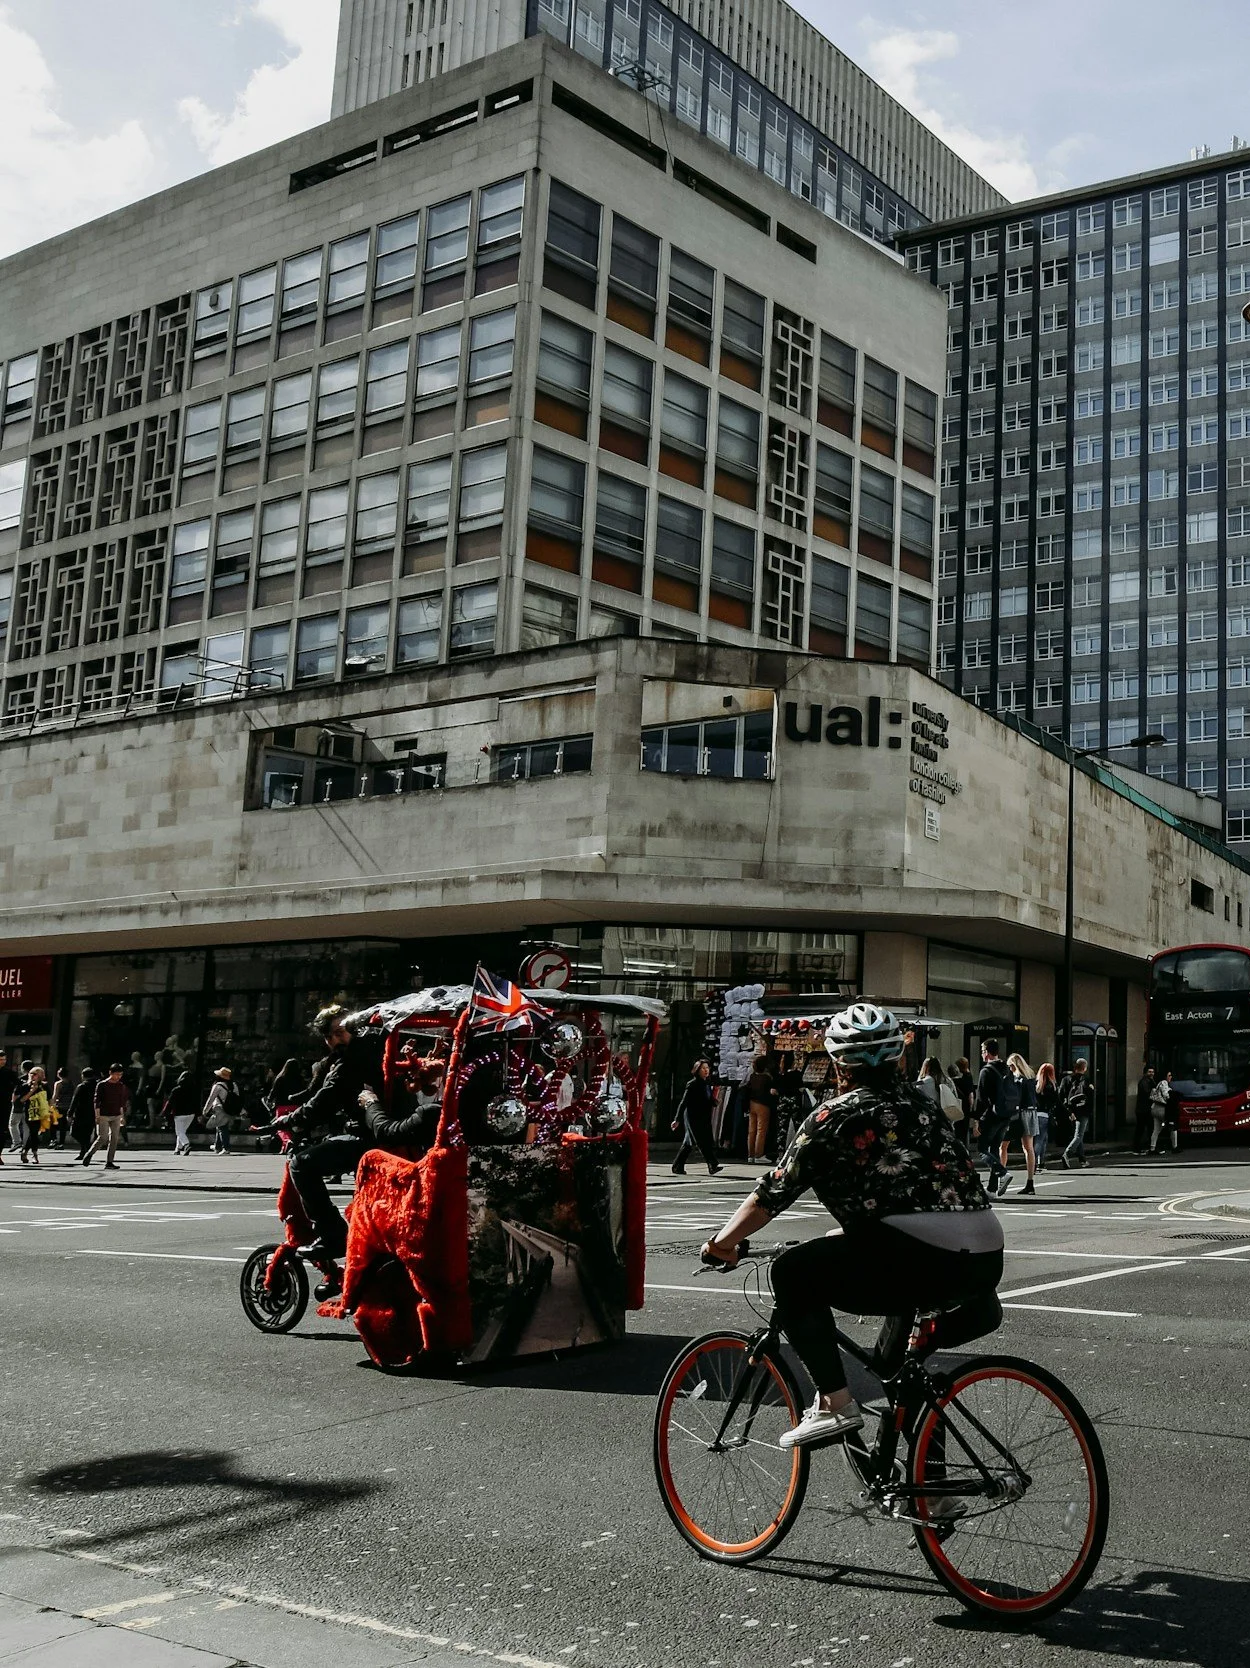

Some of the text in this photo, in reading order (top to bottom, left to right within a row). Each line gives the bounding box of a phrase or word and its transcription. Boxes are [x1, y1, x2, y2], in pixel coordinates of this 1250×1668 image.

[785, 696, 901, 748] ual:
[912, 702, 949, 732] university
[911, 736, 938, 762] london
[933, 733, 949, 749] arts
[911, 756, 963, 796] london college
[920, 783, 946, 804] fashion
[1165, 1006, 1234, 1020] East Acton 7
